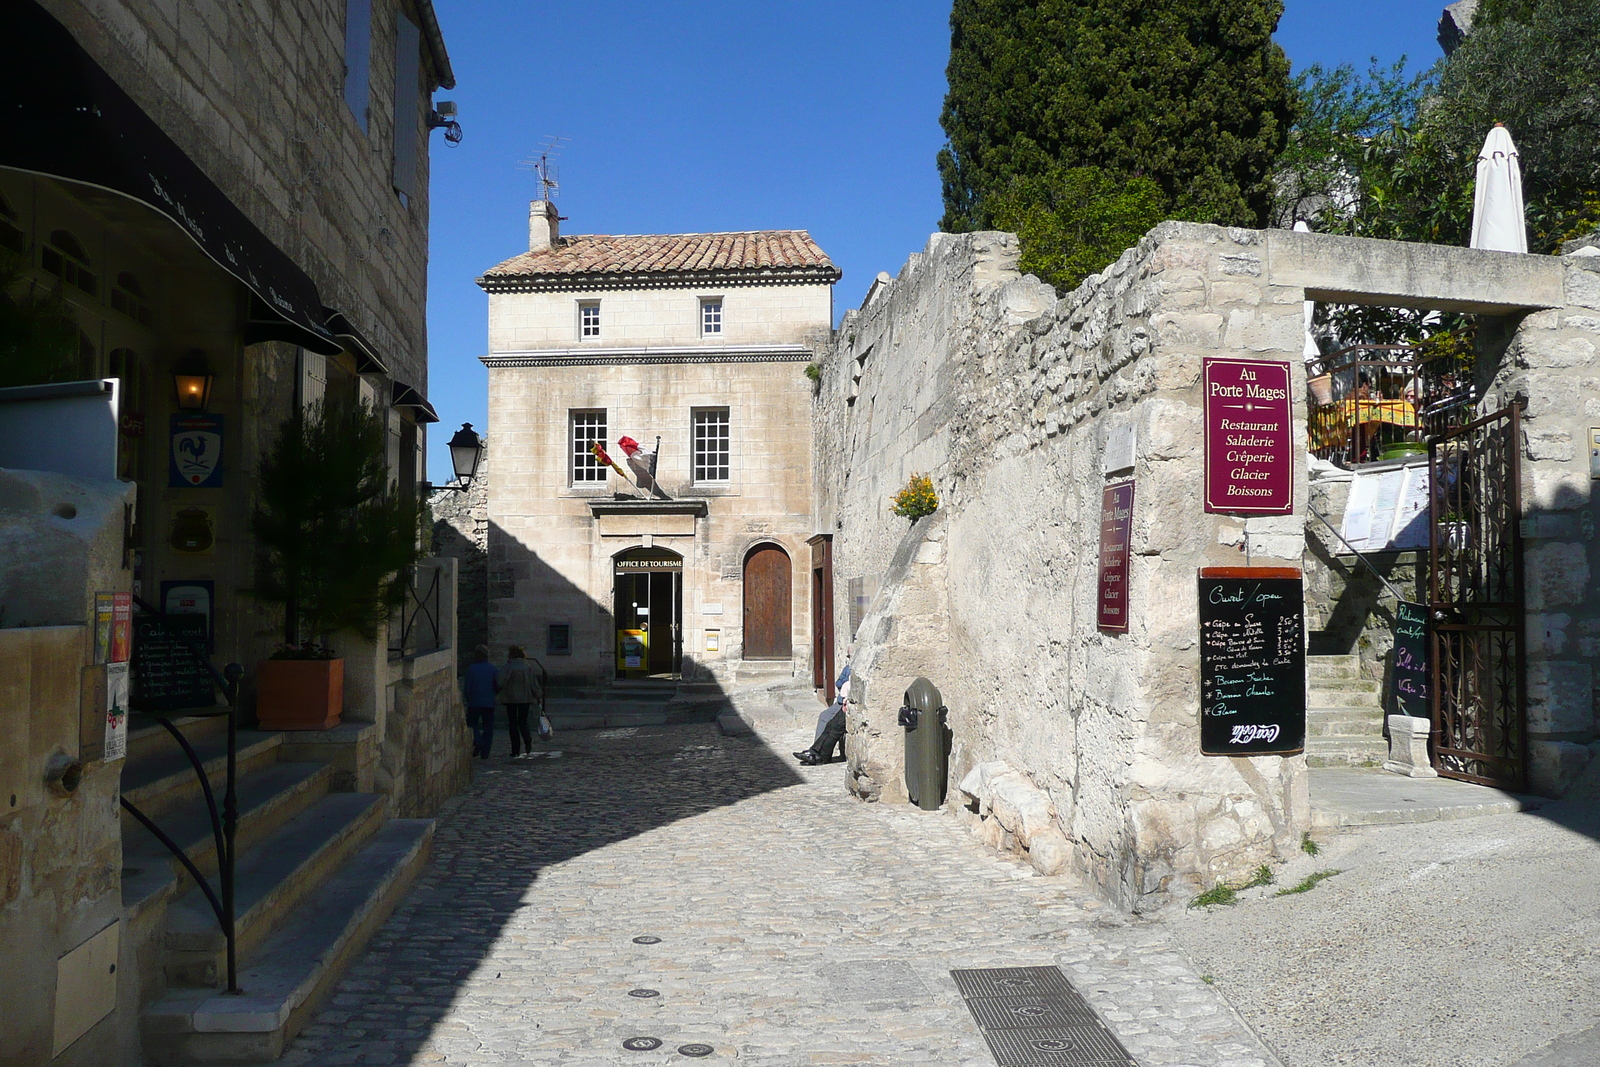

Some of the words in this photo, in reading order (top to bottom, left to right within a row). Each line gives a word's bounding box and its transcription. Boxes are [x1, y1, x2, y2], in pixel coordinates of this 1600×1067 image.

[1239, 367, 1257, 381] Au
[1210, 382, 1243, 399] Porte
[1246, 384, 1286, 401] Mages
[1220, 418, 1279, 432] Restaurant
[1225, 434, 1275, 447] Saladerie
[1226, 451, 1275, 467] Crêperie
[1230, 468, 1271, 481] Glacier
[1227, 485, 1273, 497] Boissons
[1113, 492, 1120, 504] Au
[1102, 509, 1114, 523] Porte
[1114, 507, 1129, 522] Mages
[1103, 542, 1124, 553] Restaurant
[616, 560, 639, 568] OFFICE
[640, 560, 650, 568] DE
[650, 560, 683, 568] TOURISME
[1104, 588, 1119, 600] Glacier
[1102, 604, 1121, 616] Boissons
[1228, 723, 1281, 744] Coca-Cola
